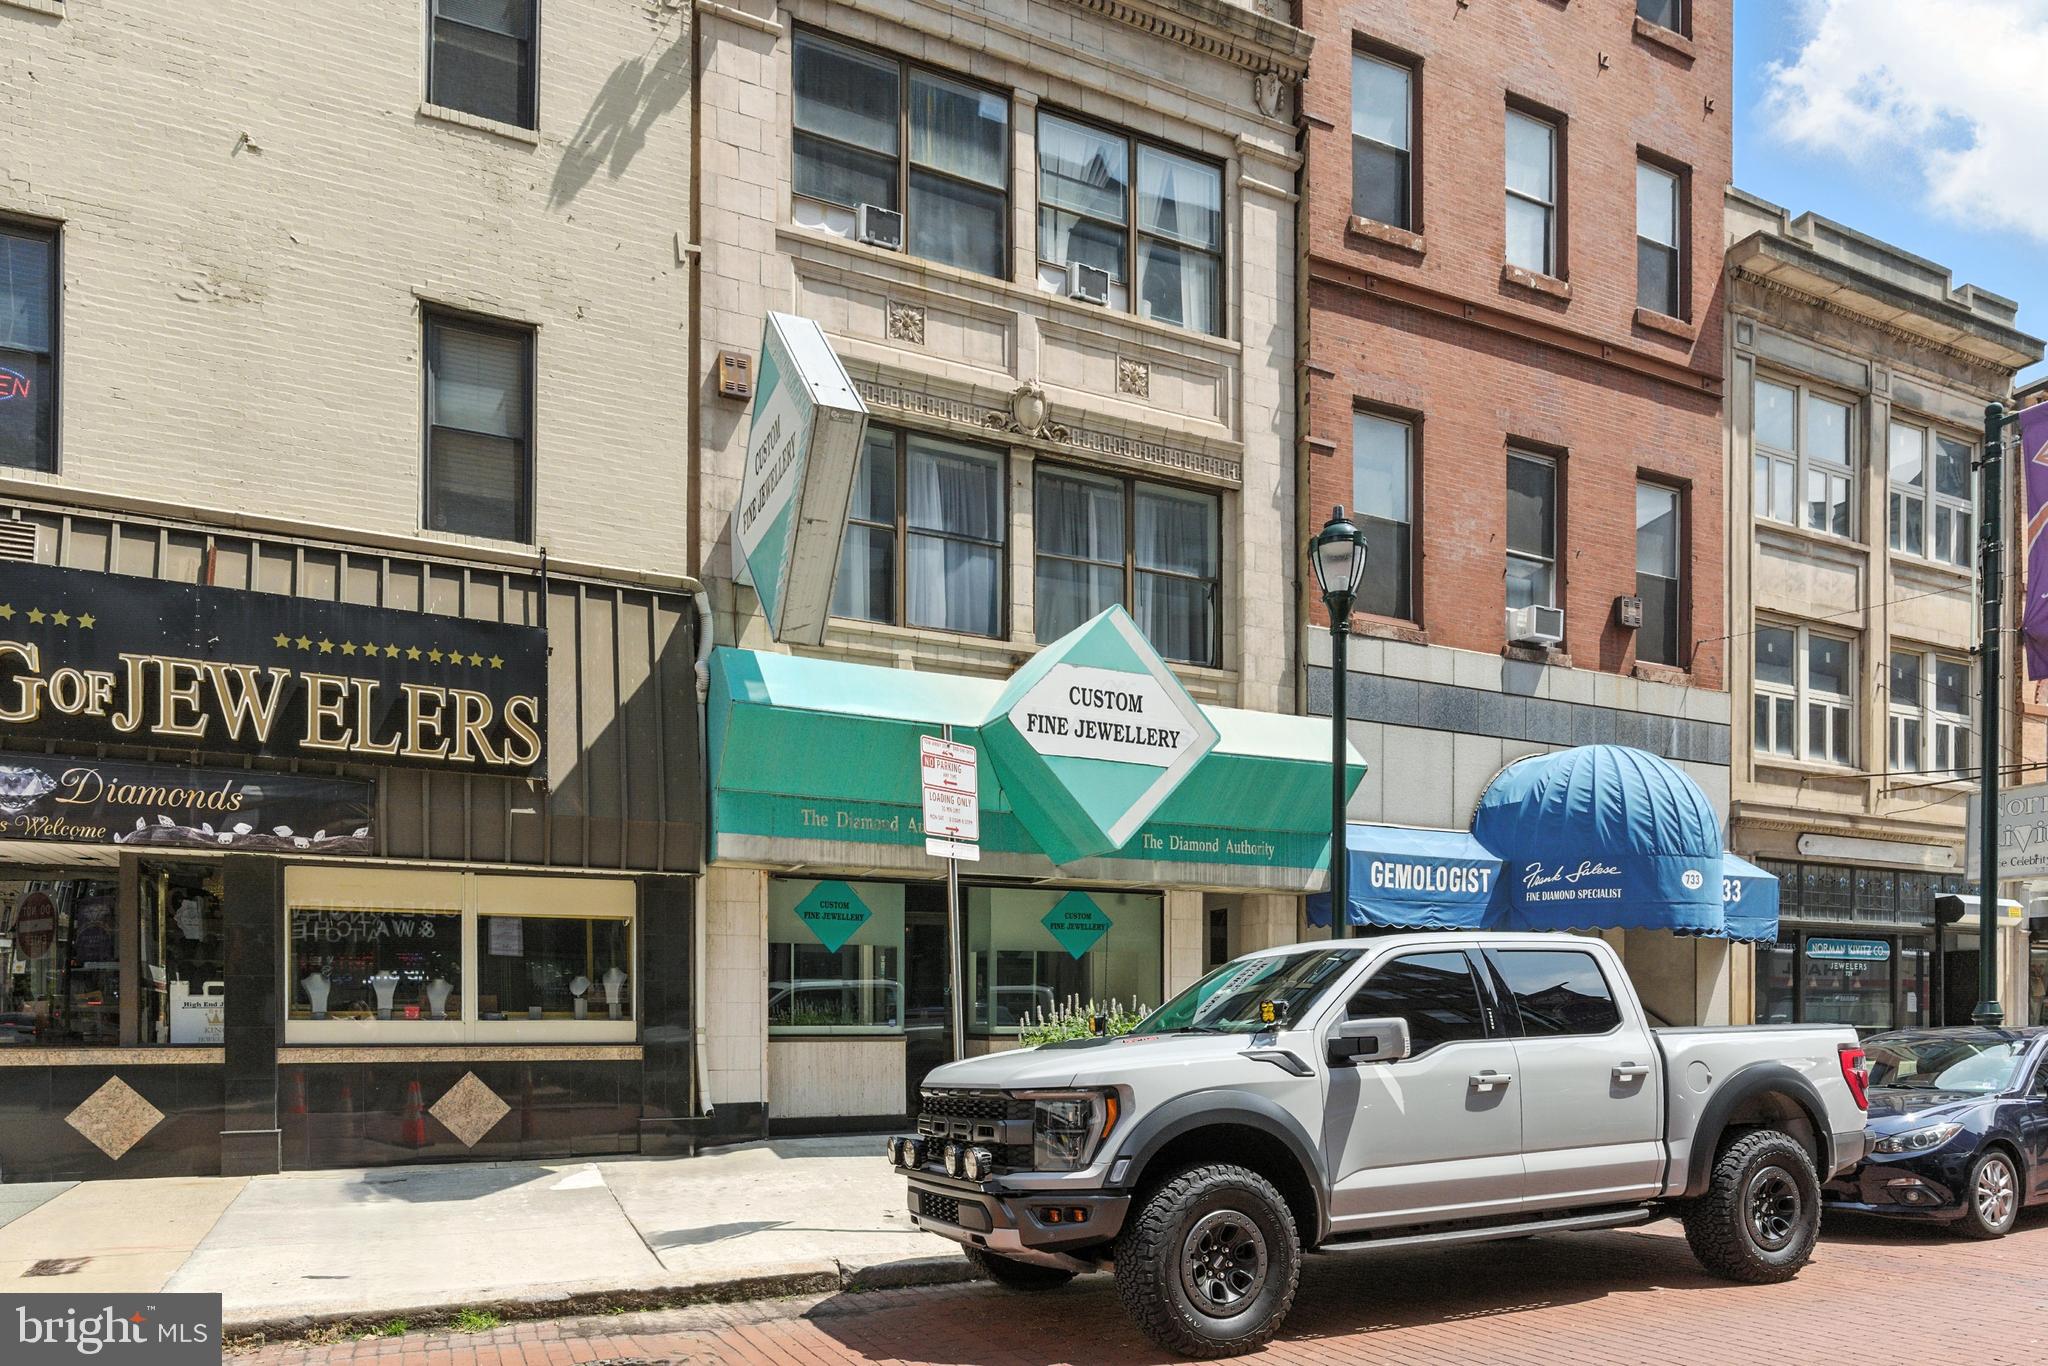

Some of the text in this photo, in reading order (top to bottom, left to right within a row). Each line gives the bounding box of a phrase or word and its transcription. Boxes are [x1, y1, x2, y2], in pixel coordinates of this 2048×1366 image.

[754, 414, 781, 476] CUSTOM
[743, 431, 796, 535] FINE JEWELLERY
[49, 667, 117, 716] OF
[111, 652, 542, 766] JEWELERS
[1069, 686, 1143, 713] CUSTOM
[1027, 713, 1180, 748] FINE JEWELLERY
[925, 755, 962, 774] NO PARKING
[55, 768, 243, 811] Diamonds
[929, 792, 972, 807] LOADING ONLY
[15, 815, 106, 838] Welcome
[801, 809, 829, 827] The
[836, 811, 899, 832] Diamond
[1143, 833, 1275, 860] The Diamond Authority
[1371, 861, 1491, 893] GEMOLOGIST
[1523, 862, 1564, 889] Frank
[1685, 874, 1700, 885] 733
[1526, 888, 1622, 901] FINE DIAMOND SPECIALIST
[1722, 879, 1741, 902] 33
[804, 912, 864, 922] FINE JEWELLERY
[819, 901, 850, 910] CUSTOM
[1064, 912, 1092, 920] CUSTOM
[1067, 923, 1106, 932] JEWELLERY
[1812, 943, 1846, 954] NORMAN
[1848, 945, 1872, 956] KIVITZ
[1830, 962, 1867, 971] JEWELERS
[917, 1113, 1006, 1143] FORD
